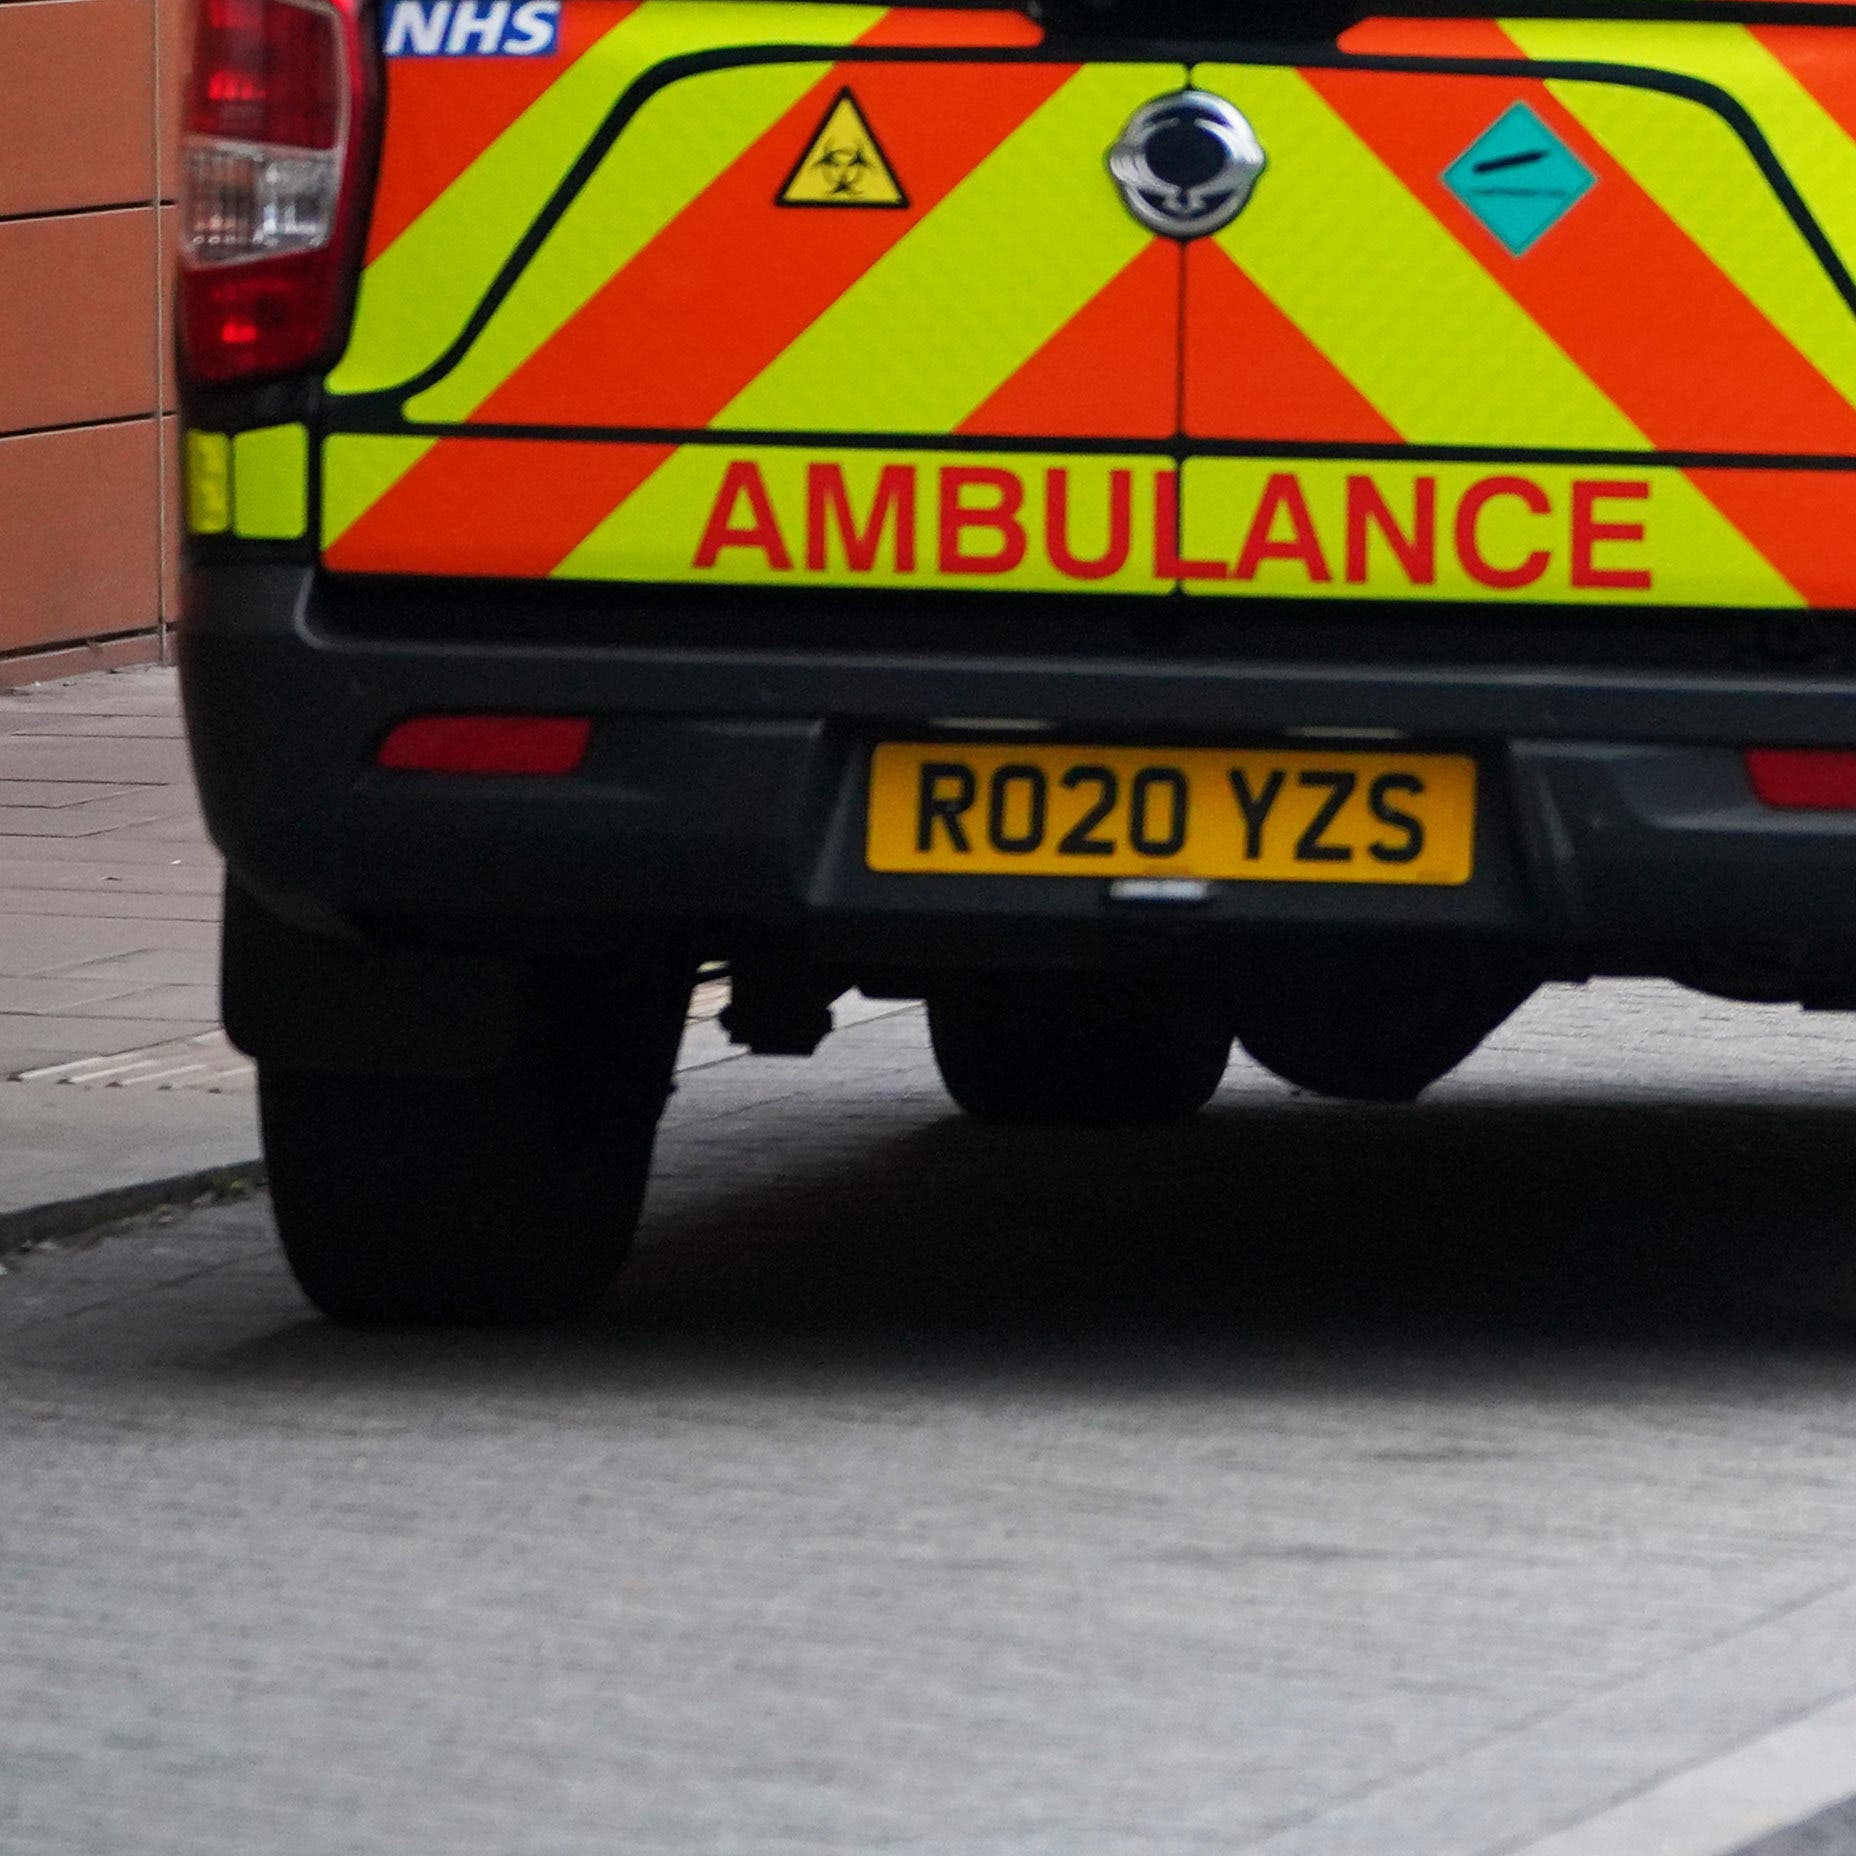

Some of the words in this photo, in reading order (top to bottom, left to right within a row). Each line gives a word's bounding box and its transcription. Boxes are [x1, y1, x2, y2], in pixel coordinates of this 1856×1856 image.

[384, 0, 561, 56] NHS
[693, 459, 1653, 592] AMBULANCE
[916, 763, 1189, 858] RO20
[1229, 769, 1426, 863] YZS
